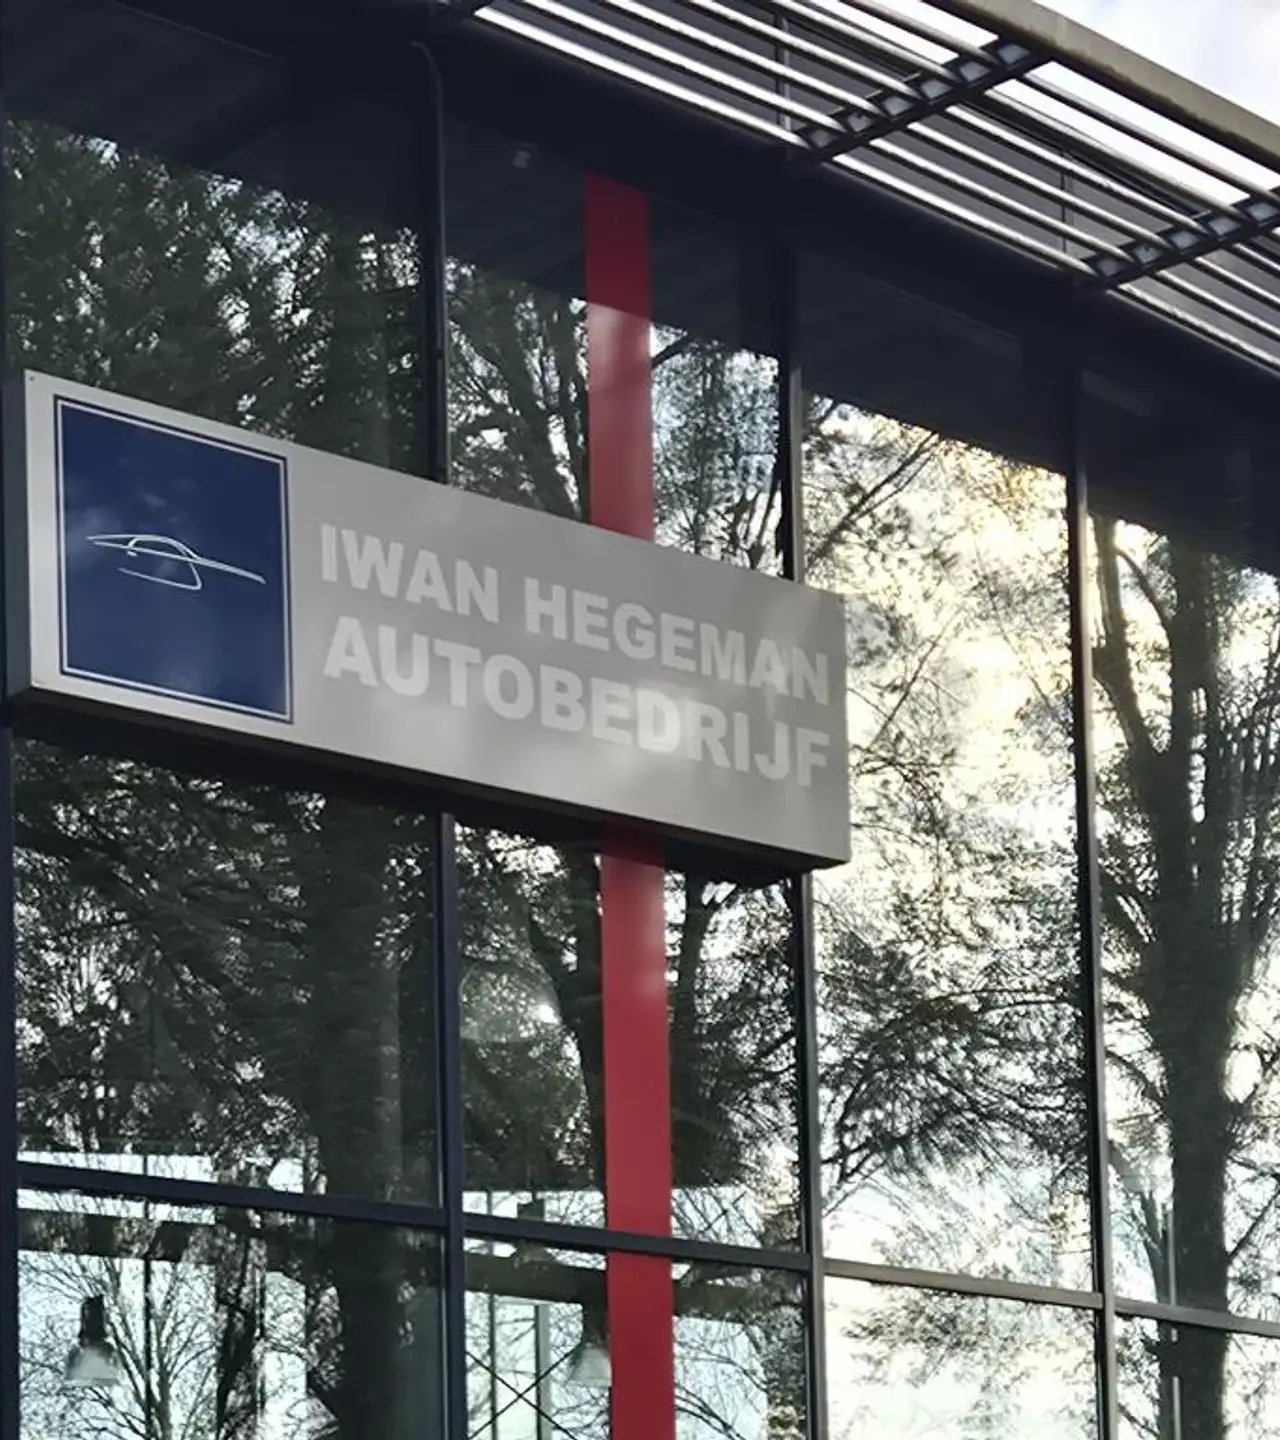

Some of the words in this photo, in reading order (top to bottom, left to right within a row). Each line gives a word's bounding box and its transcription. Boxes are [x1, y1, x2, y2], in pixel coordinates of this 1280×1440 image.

[322, 524, 499, 622] IWAN
[526, 574, 830, 706] HEGEMAN
[322, 616, 831, 789] AUTOBEDRIJF
